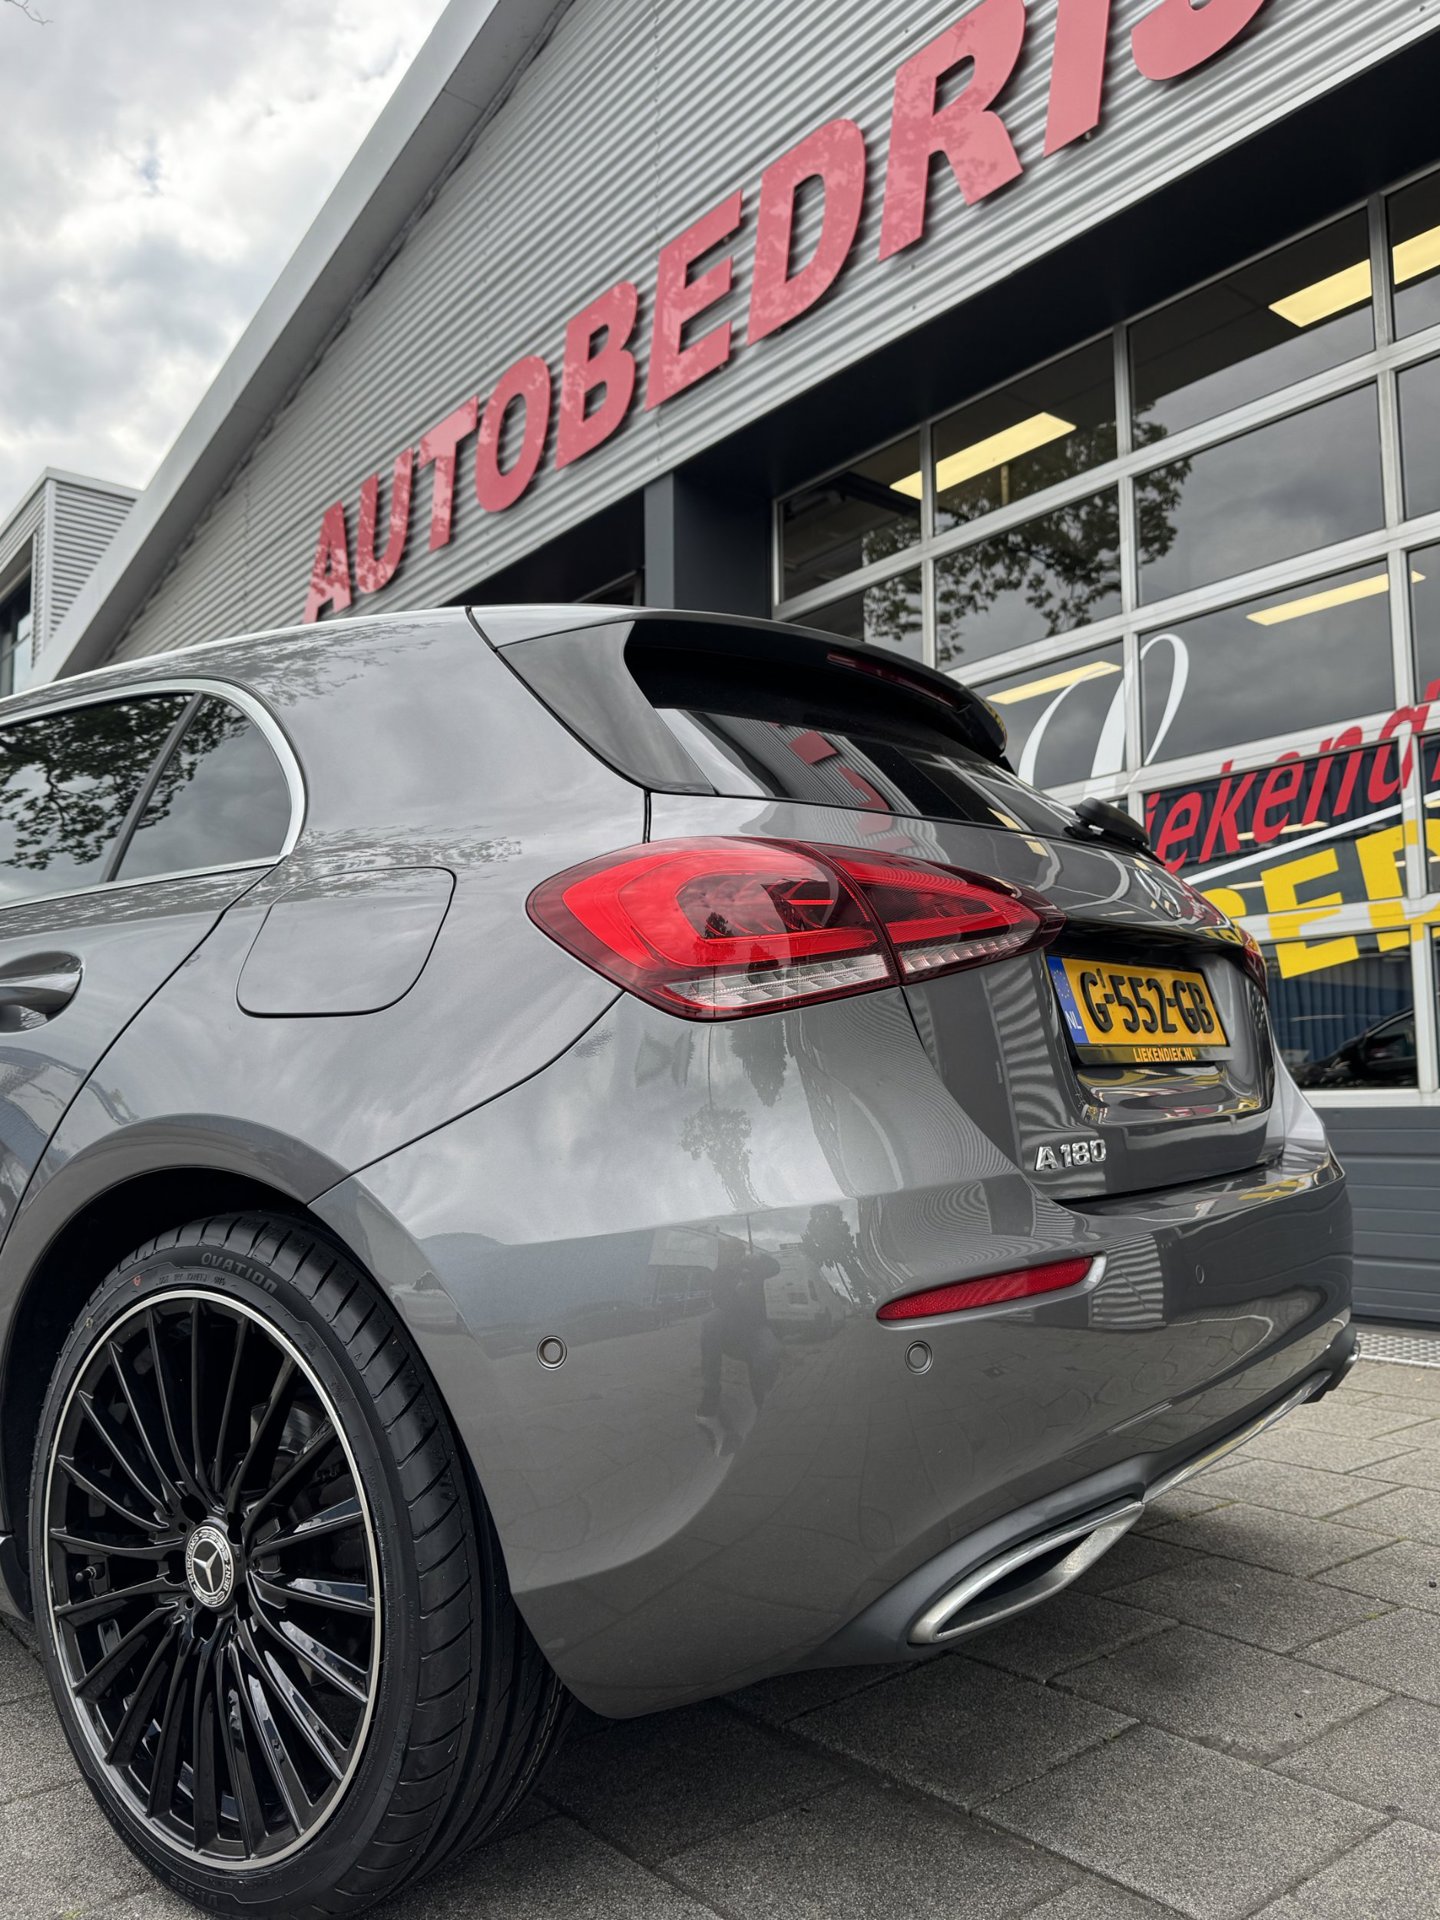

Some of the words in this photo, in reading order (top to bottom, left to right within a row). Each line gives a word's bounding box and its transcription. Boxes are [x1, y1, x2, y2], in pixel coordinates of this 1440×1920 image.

[1065, 1011, 1083, 1031] NL
[1080, 970, 1215, 1034] G-552-GB
[1133, 1047, 1196, 1062] LIEKENDIEK.NL
[1035, 1146, 1058, 1171] A
[1060, 1139, 1107, 1168] 180
[201, 1252, 278, 1294] OVATION
[223, 1563, 232, 1592] BENZ
